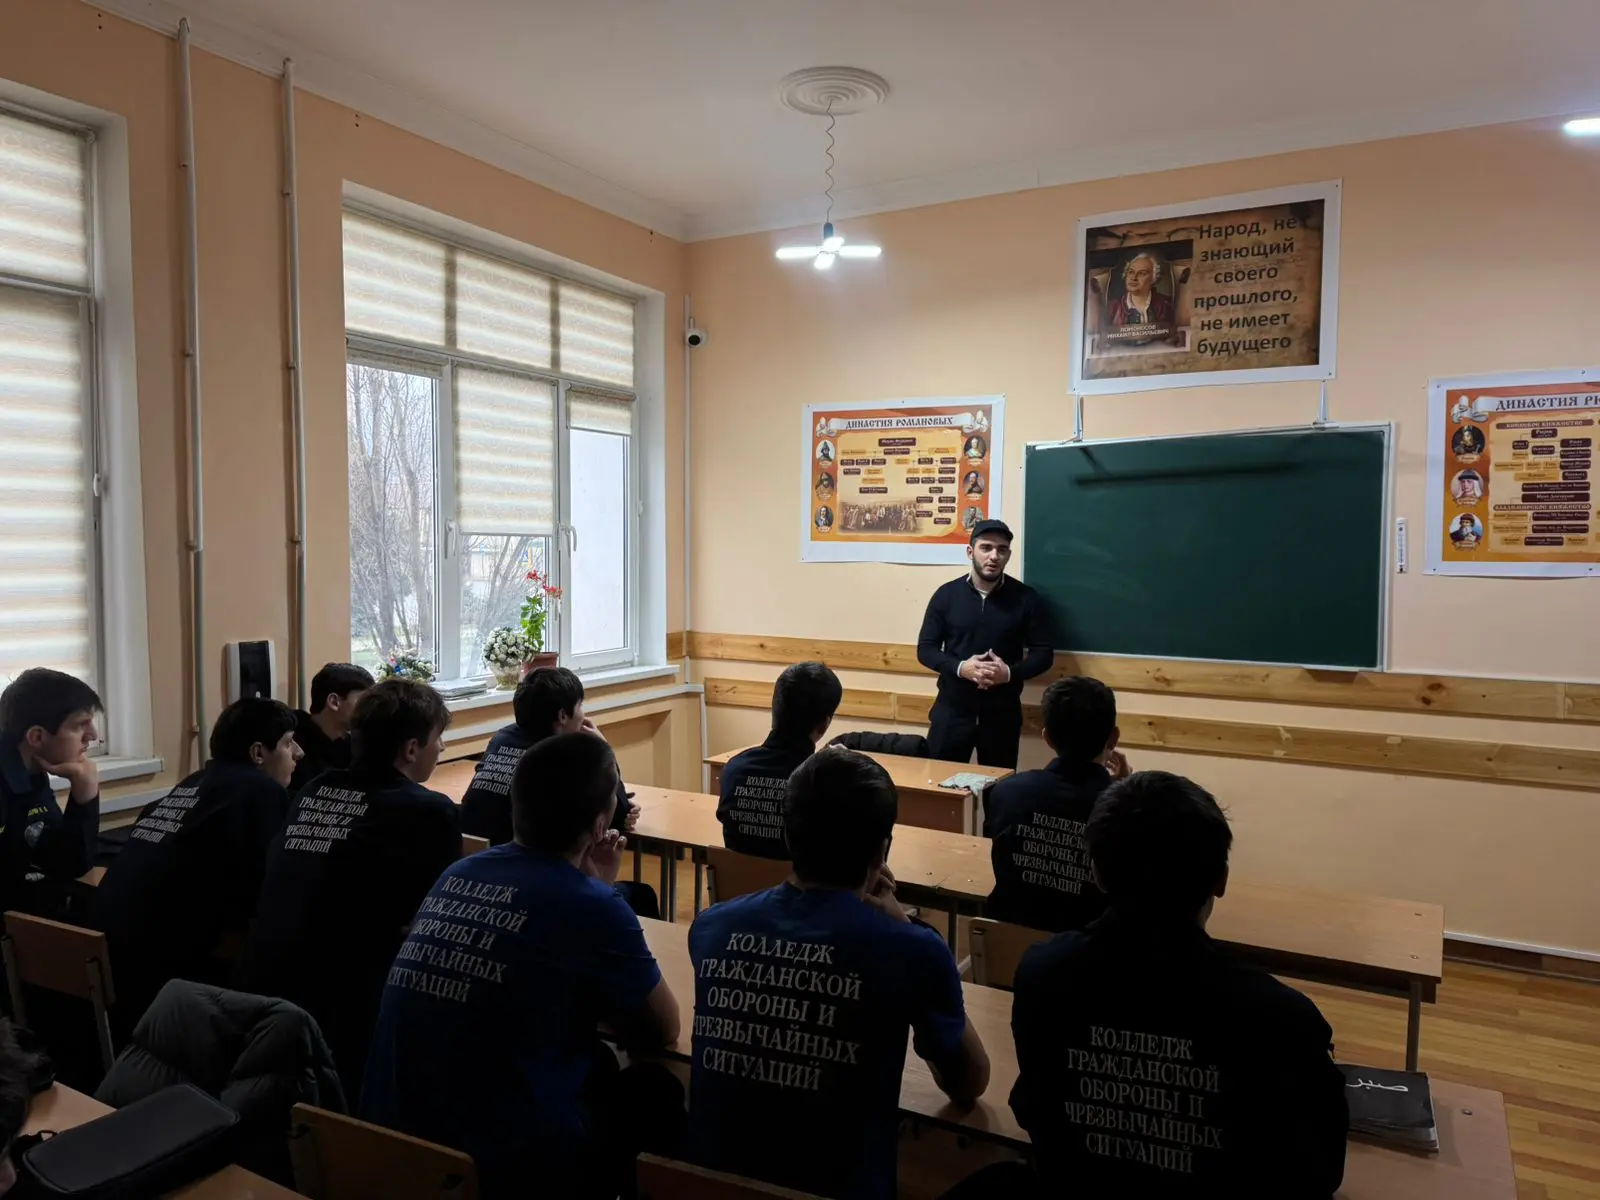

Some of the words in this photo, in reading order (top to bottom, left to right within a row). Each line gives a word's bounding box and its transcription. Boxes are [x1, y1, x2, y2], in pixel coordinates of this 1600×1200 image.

[1199, 221, 1267, 240] Народ,
[1273, 217, 1298, 231] не
[1199, 237, 1294, 262] знающий
[1214, 267, 1279, 284] своего
[1194, 289, 1298, 311] прошлого,
[1200, 317, 1223, 331] не
[1229, 312, 1290, 329] имеет
[1197, 336, 1292, 357] будущего
[1495, 396, 1578, 411] ДИНАСТИЯ
[845, 419, 893, 429] ДИНАСТИЯ
[896, 417, 953, 427] РОМАНОВЫХ
[315, 785, 366, 803] КОЛЛЕДЖ
[737, 798, 778, 813] ОБОРОНЫ
[297, 809, 343, 825] ОБОРОНЫ
[340, 816, 355, 826] И
[298, 796, 369, 816] ГРАЖДАНСКОЙ
[738, 823, 782, 839] СИТУАЦИЙ
[284, 838, 332, 854] СИТУАЦИЙ
[1023, 839, 1079, 863] ОБОРОНЫ
[441, 875, 519, 904] КОЛЛЕДЖ
[1021, 869, 1083, 895] СИТУАЦИЙ
[477, 931, 498, 951] И
[726, 932, 835, 966] КОЛЛЕДЖ
[699, 957, 863, 1001] ГРАЖДАНСКОЙ
[707, 986, 811, 1022] ОБОРОНЫ
[817, 1003, 838, 1028] И
[1089, 1024, 1193, 1061] КОЛЛЕДЖ
[702, 1046, 823, 1092] СИТУАЦИЙ
[1066, 1047, 1221, 1094] ГРАЖДАНСКОЙ
[1080, 1076, 1181, 1114] ОБОРОНЫ
[1187, 1093, 1206, 1120] И
[1064, 1100, 1224, 1150] ЧРЕЗВЫЧАЙНЫХ
[1085, 1131, 1194, 1174] СИТУАЦИЙ
